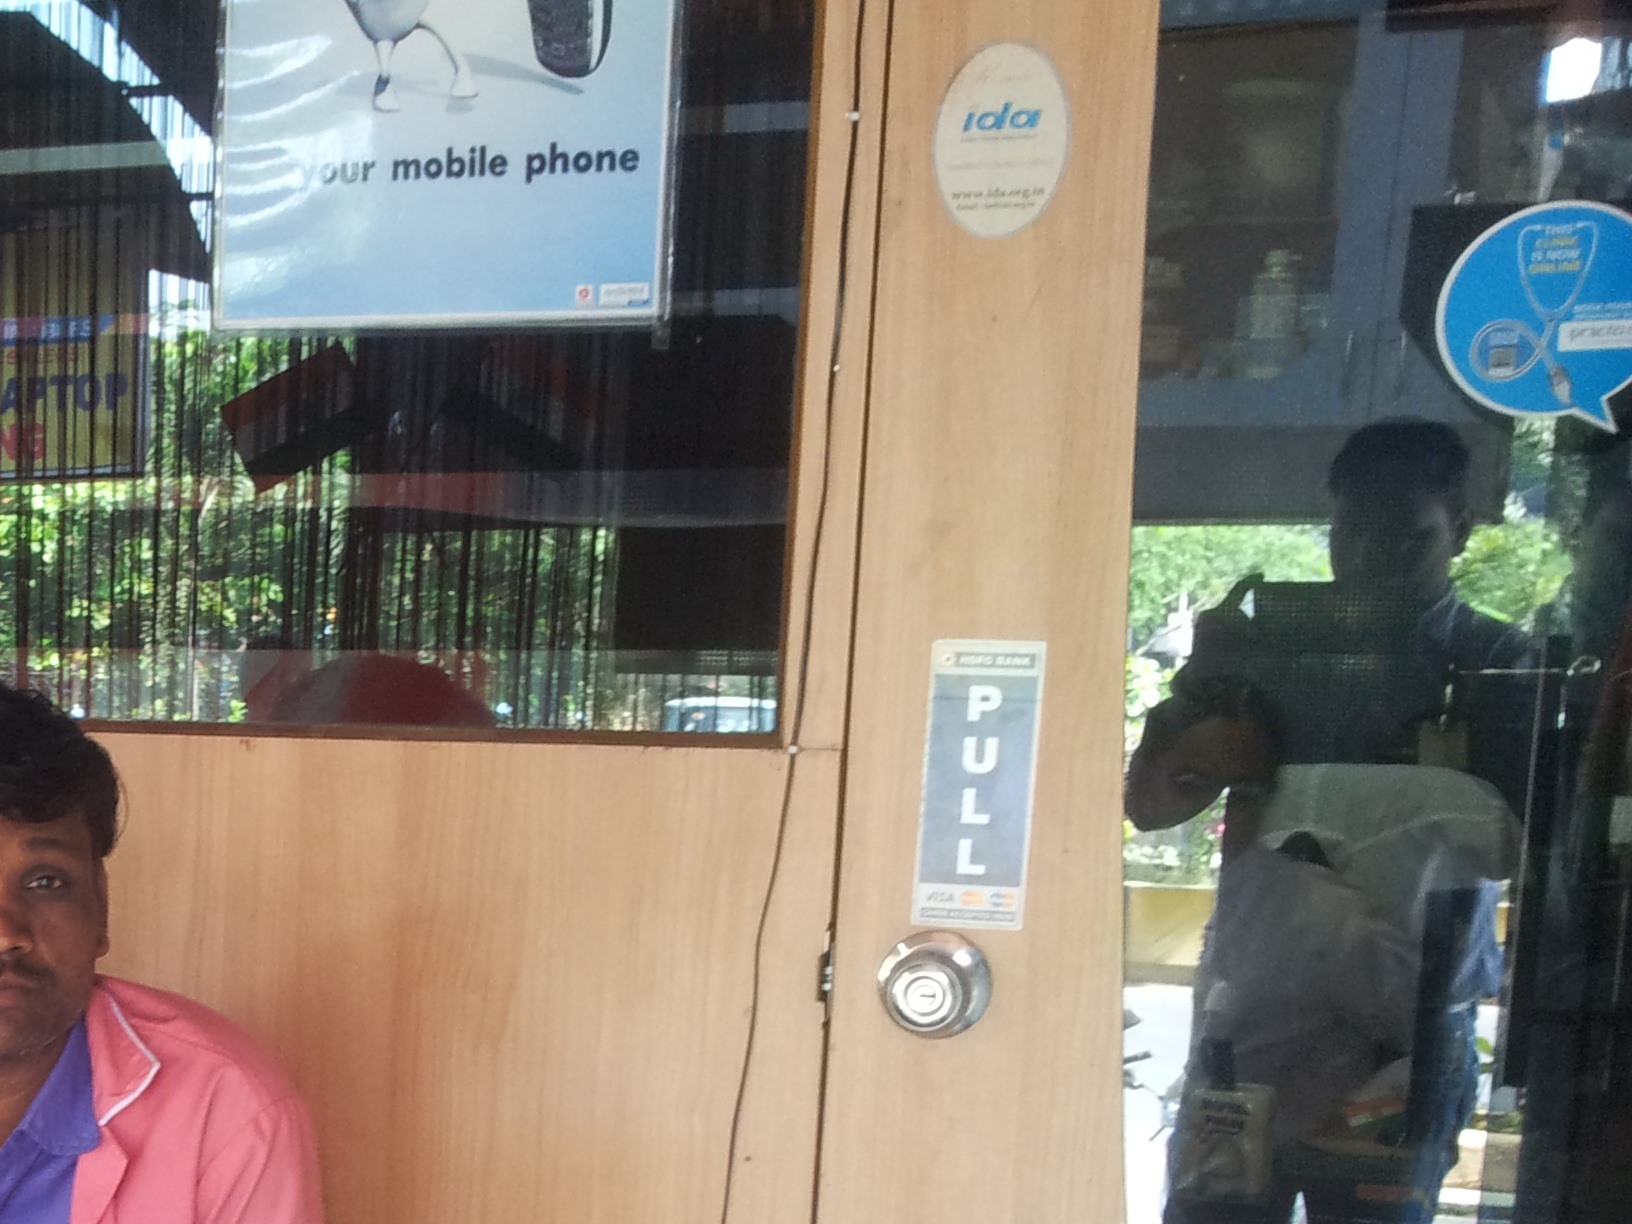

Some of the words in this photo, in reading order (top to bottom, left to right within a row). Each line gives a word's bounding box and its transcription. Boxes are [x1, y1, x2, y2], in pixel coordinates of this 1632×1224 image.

[391, 145, 508, 181] mobile
[524, 142, 640, 184] phone
[956, 684, 1003, 876] PULL
